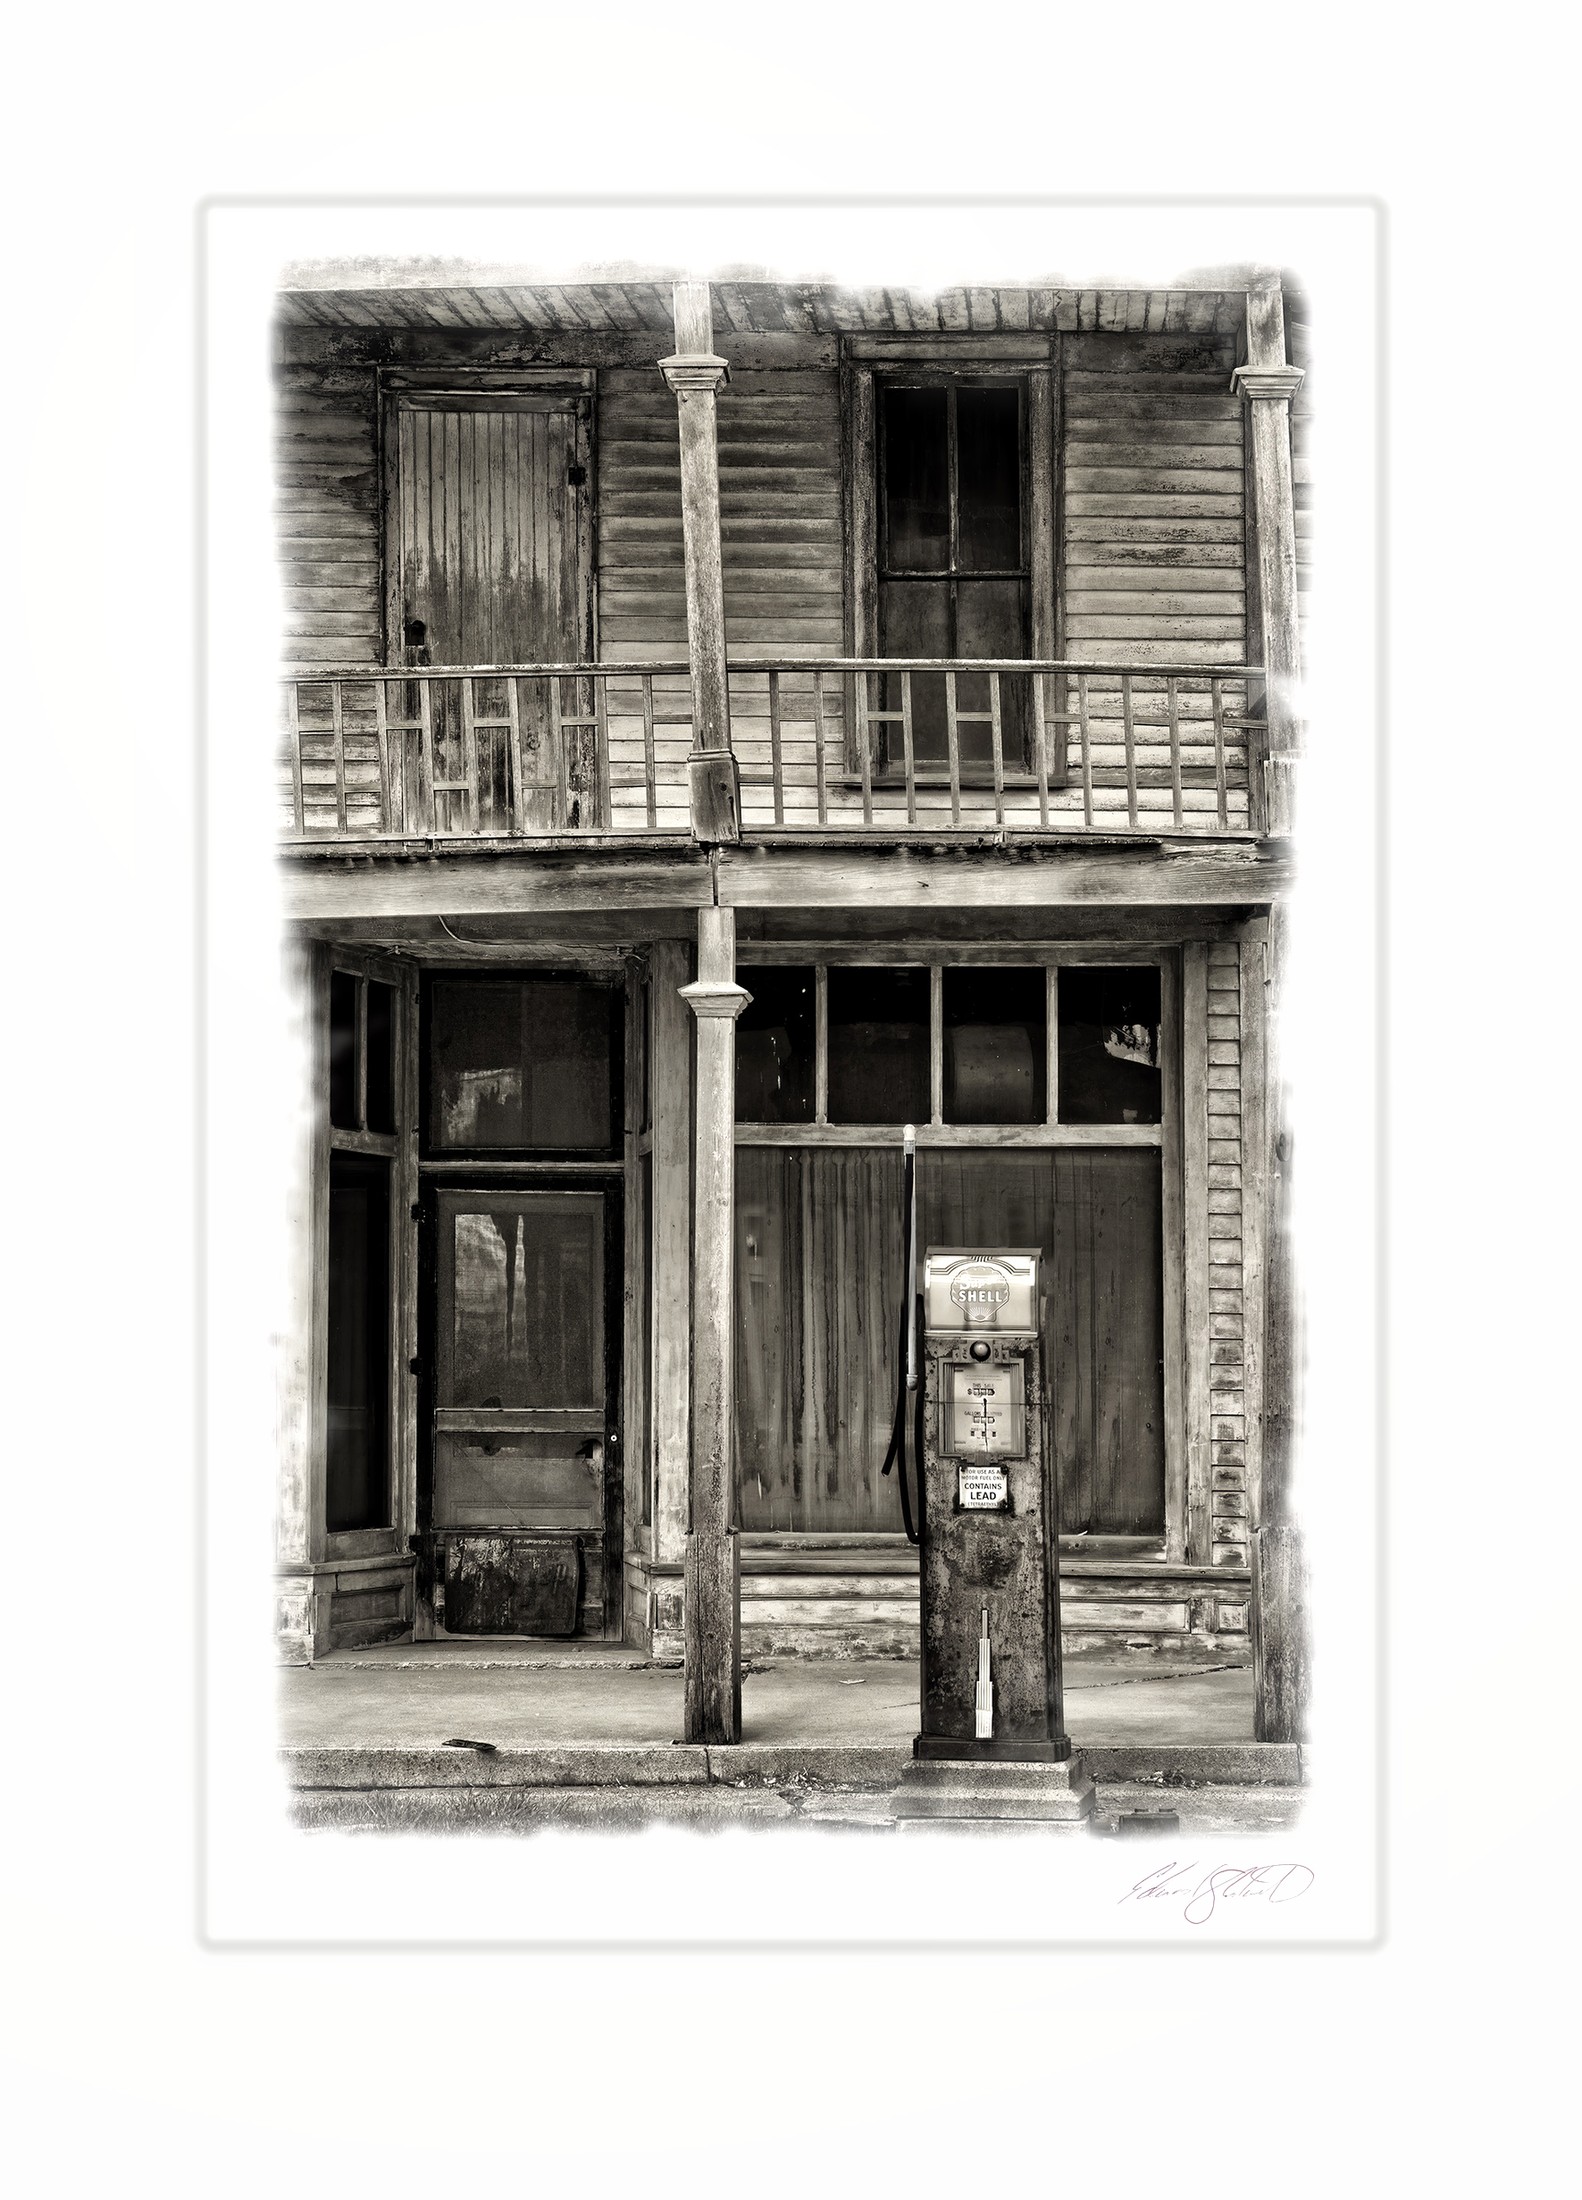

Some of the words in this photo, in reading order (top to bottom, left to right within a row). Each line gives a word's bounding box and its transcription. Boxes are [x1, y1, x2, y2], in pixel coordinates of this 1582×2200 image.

[958, 1290, 1003, 1303] SHELL
[964, 1482, 1002, 1490] CONTAINS
[970, 1491, 997, 1500] LEAD
